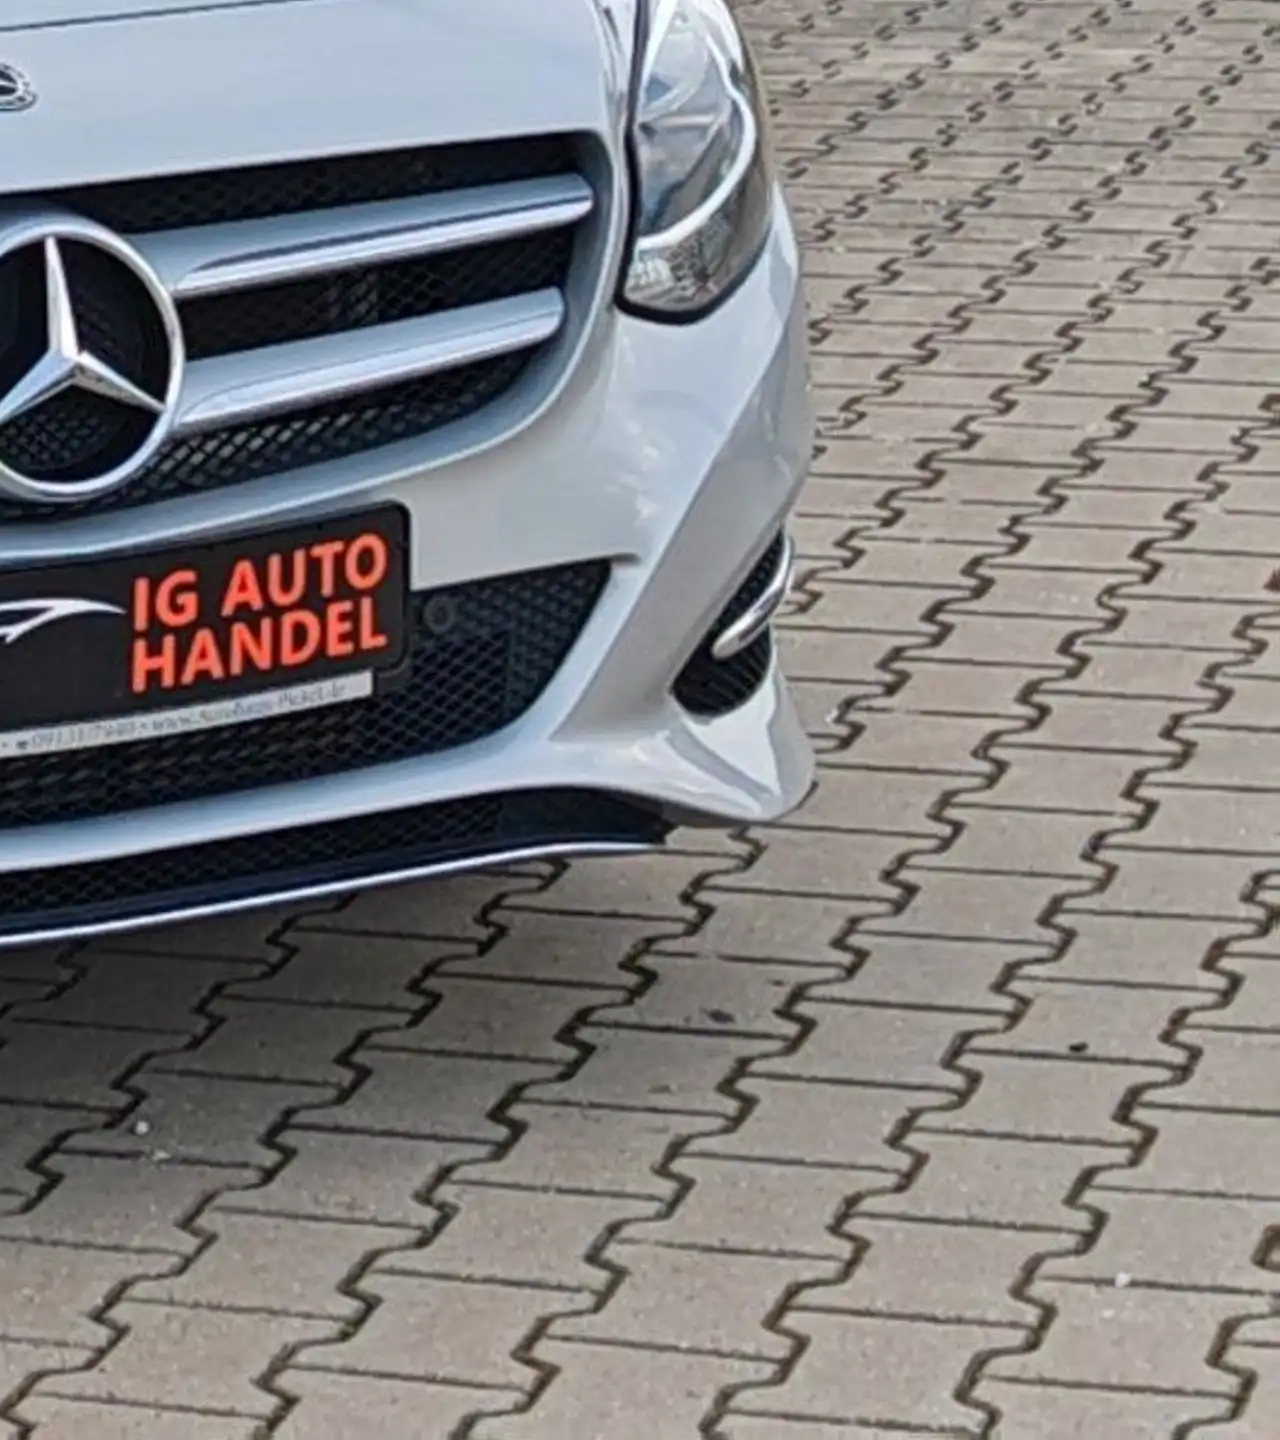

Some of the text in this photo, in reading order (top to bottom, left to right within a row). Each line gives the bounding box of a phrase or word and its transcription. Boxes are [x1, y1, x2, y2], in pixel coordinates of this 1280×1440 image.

[133, 532, 388, 633] IG AUTO
[132, 595, 389, 694] HANDEL
